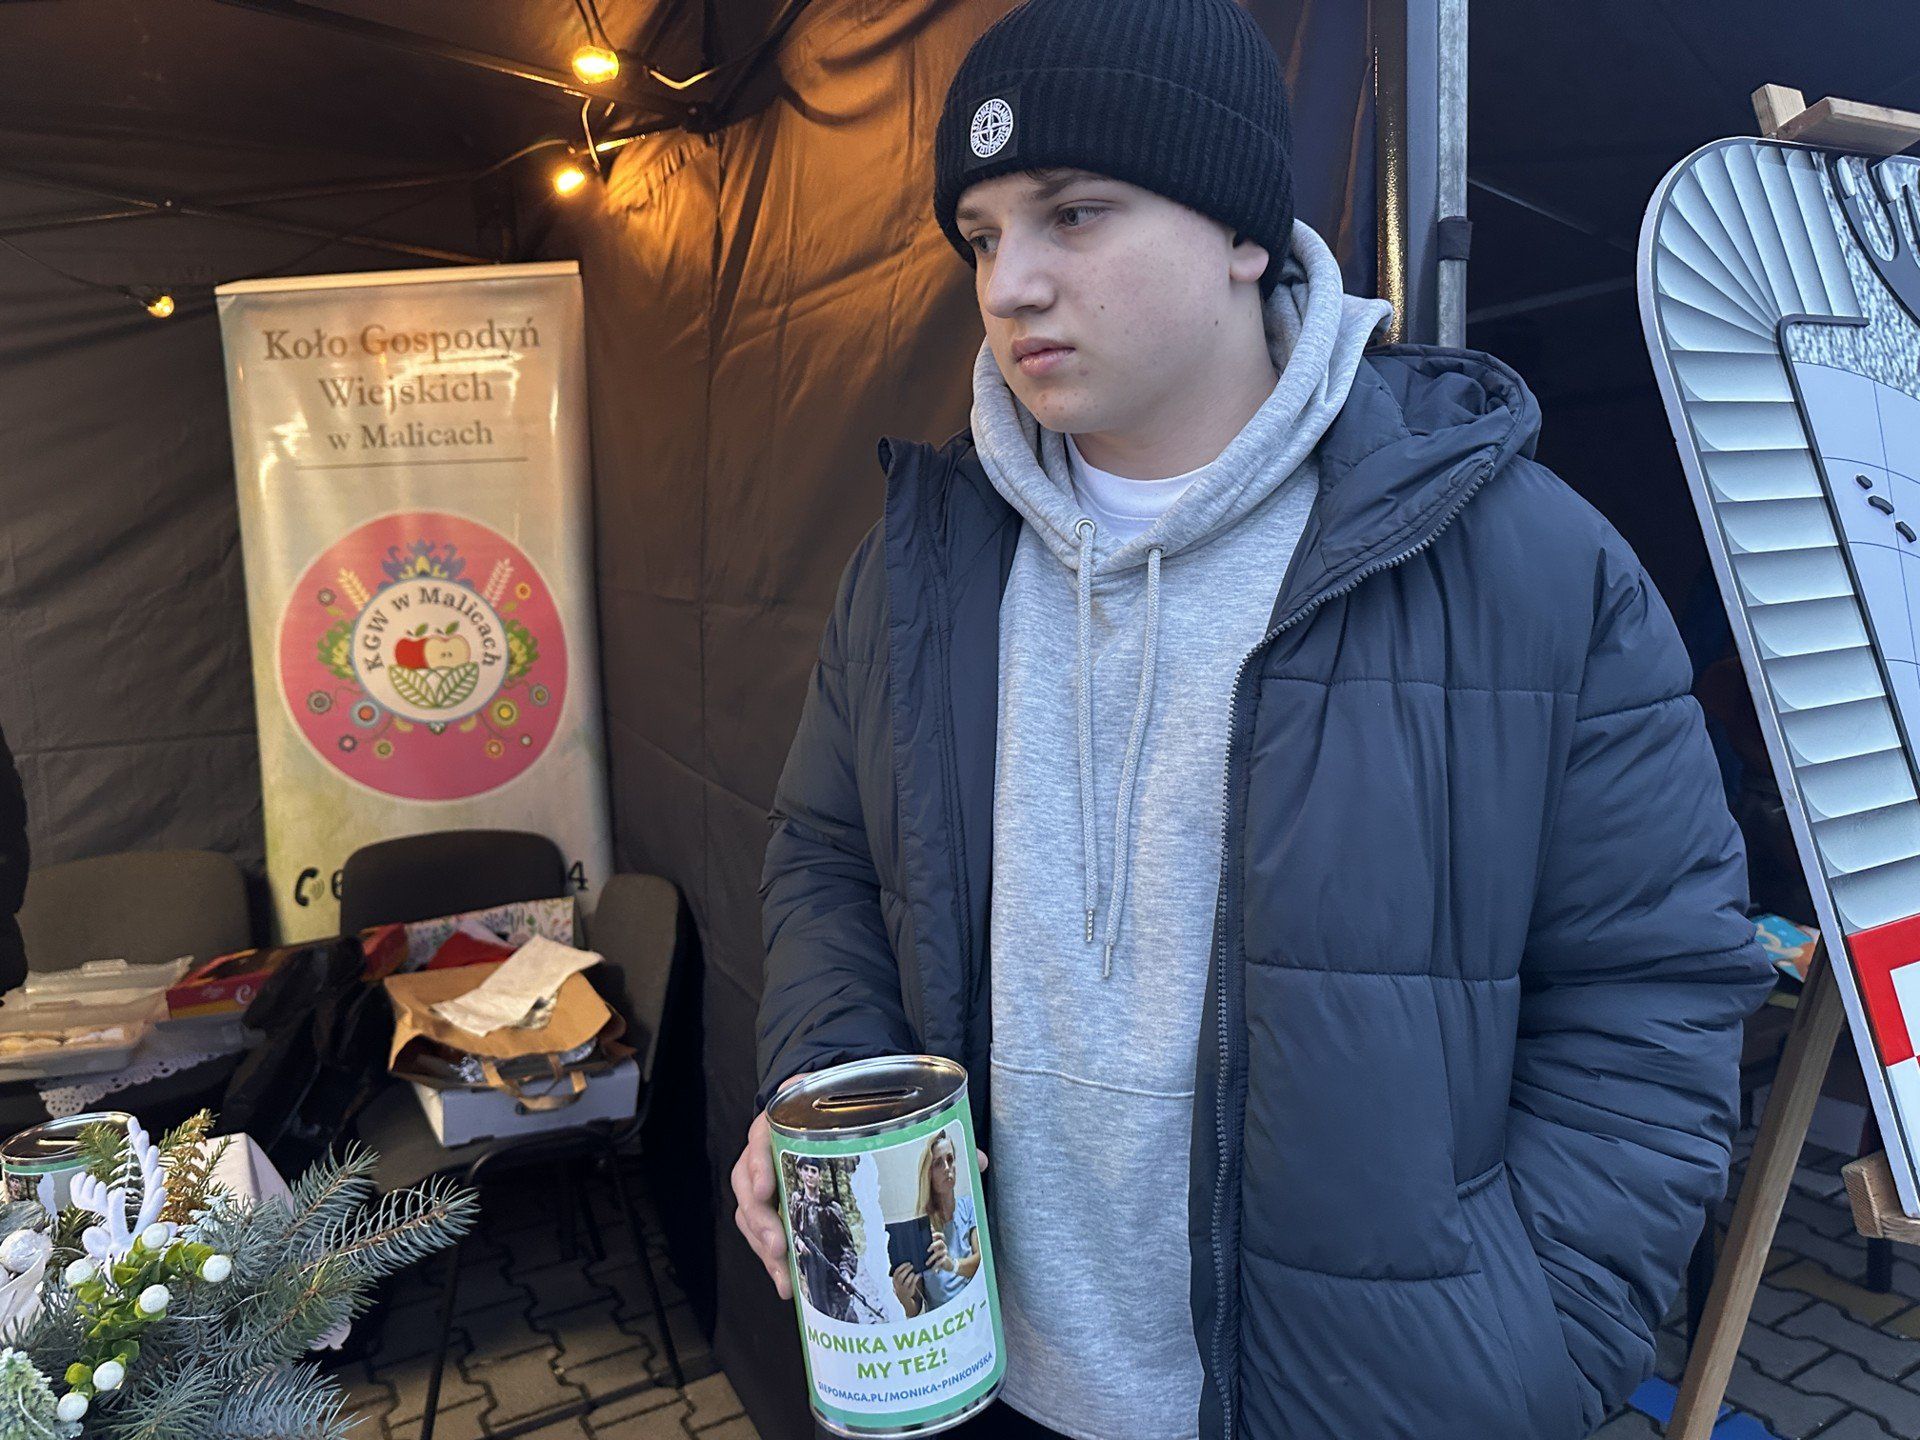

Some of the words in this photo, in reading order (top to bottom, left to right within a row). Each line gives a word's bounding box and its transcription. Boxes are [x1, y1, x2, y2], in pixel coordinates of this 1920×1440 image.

[263, 327, 348, 361] Koło
[360, 318, 540, 361] Gospodyń
[318, 373, 494, 411] Wiejskich
[328, 433, 351, 451] w
[361, 421, 493, 449] Malicach
[363, 609, 389, 671] KGW
[392, 594, 410, 611] w
[418, 587, 502, 666] Malicach
[808, 1325, 888, 1354] MONIKA
[892, 1307, 976, 1351] WALCZY
[857, 1362, 892, 1379] MY
[898, 1347, 948, 1376] TEŻ!
